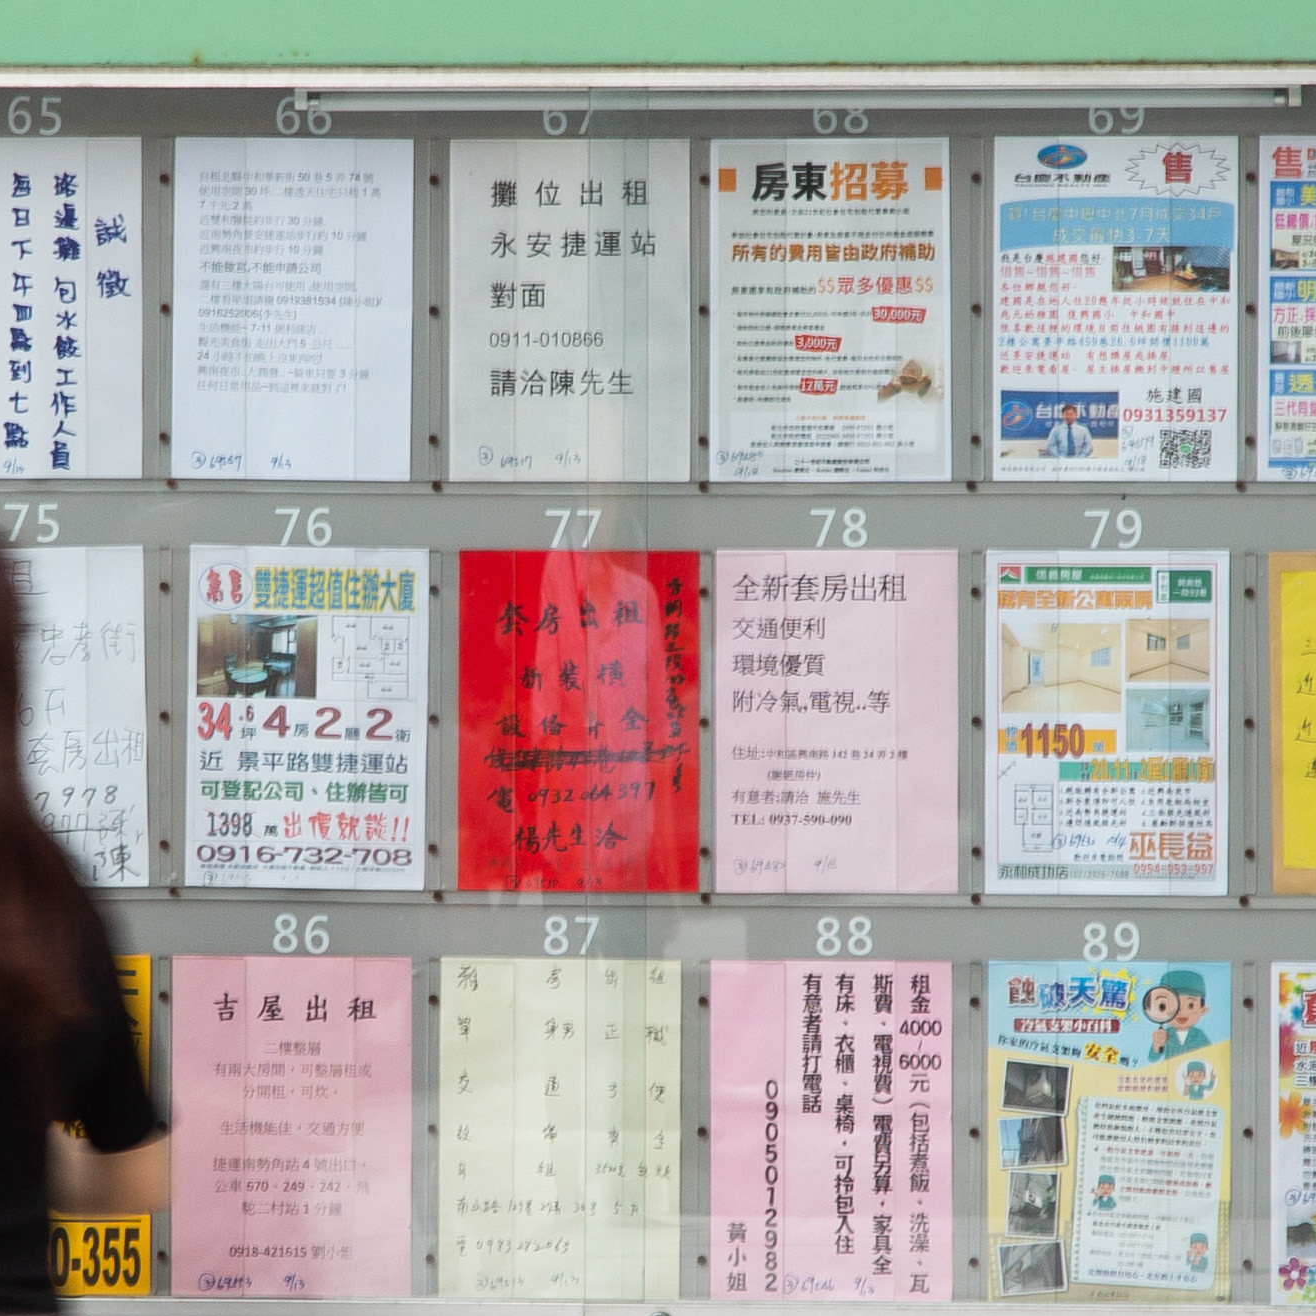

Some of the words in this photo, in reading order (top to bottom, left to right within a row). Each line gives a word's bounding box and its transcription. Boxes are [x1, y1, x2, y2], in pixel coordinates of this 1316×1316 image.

[8, 96, 64, 135] 65
[276, 97, 332, 135] 66
[812, 108, 869, 134] 68
[1088, 107, 1145, 133] 69
[1162, 151, 1194, 184] 售
[1272, 146, 1303, 179] 售
[490, 178, 650, 208] 攤位出租
[752, 161, 909, 202] 房東招募
[95, 213, 132, 299] 誠徵
[490, 231, 656, 258] 永安捷運站
[731, 243, 935, 263] 所有的費用皆由政府補助
[490, 282, 546, 310] 對面
[489, 331, 604, 348] 0911-010866
[490, 369, 634, 397] 請洽陳先生
[1146, 387, 1203, 404] 施建國
[1123, 408, 1228, 422] 0931359137
[3, 504, 61, 542] 75
[273, 507, 333, 547] 76
[545, 508, 603, 549] 77
[810, 508, 869, 548] 78
[1084, 509, 1143, 549] 79
[254, 566, 416, 613] 雙捷運超值住辦大廈
[732, 573, 908, 603] 全新套房出租
[494, 601, 644, 636] 套房出租
[732, 616, 826, 640] 交通便利
[732, 653, 826, 678] 環境優質
[1021, 722, 1086, 759] 1150
[200, 751, 223, 771] 近
[237, 751, 408, 774] 景平路雙捷運站
[201, 780, 409, 804] 可登記公司、住辦皆可
[816, 790, 861, 805] 施先生
[732, 814, 765, 826] TEL:
[768, 814, 853, 826] 0937-590-090
[196, 845, 413, 866] 0916-732-708
[1130, 832, 1213, 861] 巫長益
[1000, 866, 1069, 880] 永和成功店
[272, 914, 332, 954] 86
[543, 916, 601, 956] 87
[815, 917, 874, 957] 88
[1082, 921, 1140, 962] 89
[213, 992, 377, 1022] 吉屋出租
[802, 974, 822, 1115] 有意者請打電話
[765, 1081, 779, 1293] 0905012982
[727, 1222, 747, 1292] 黃小姐
